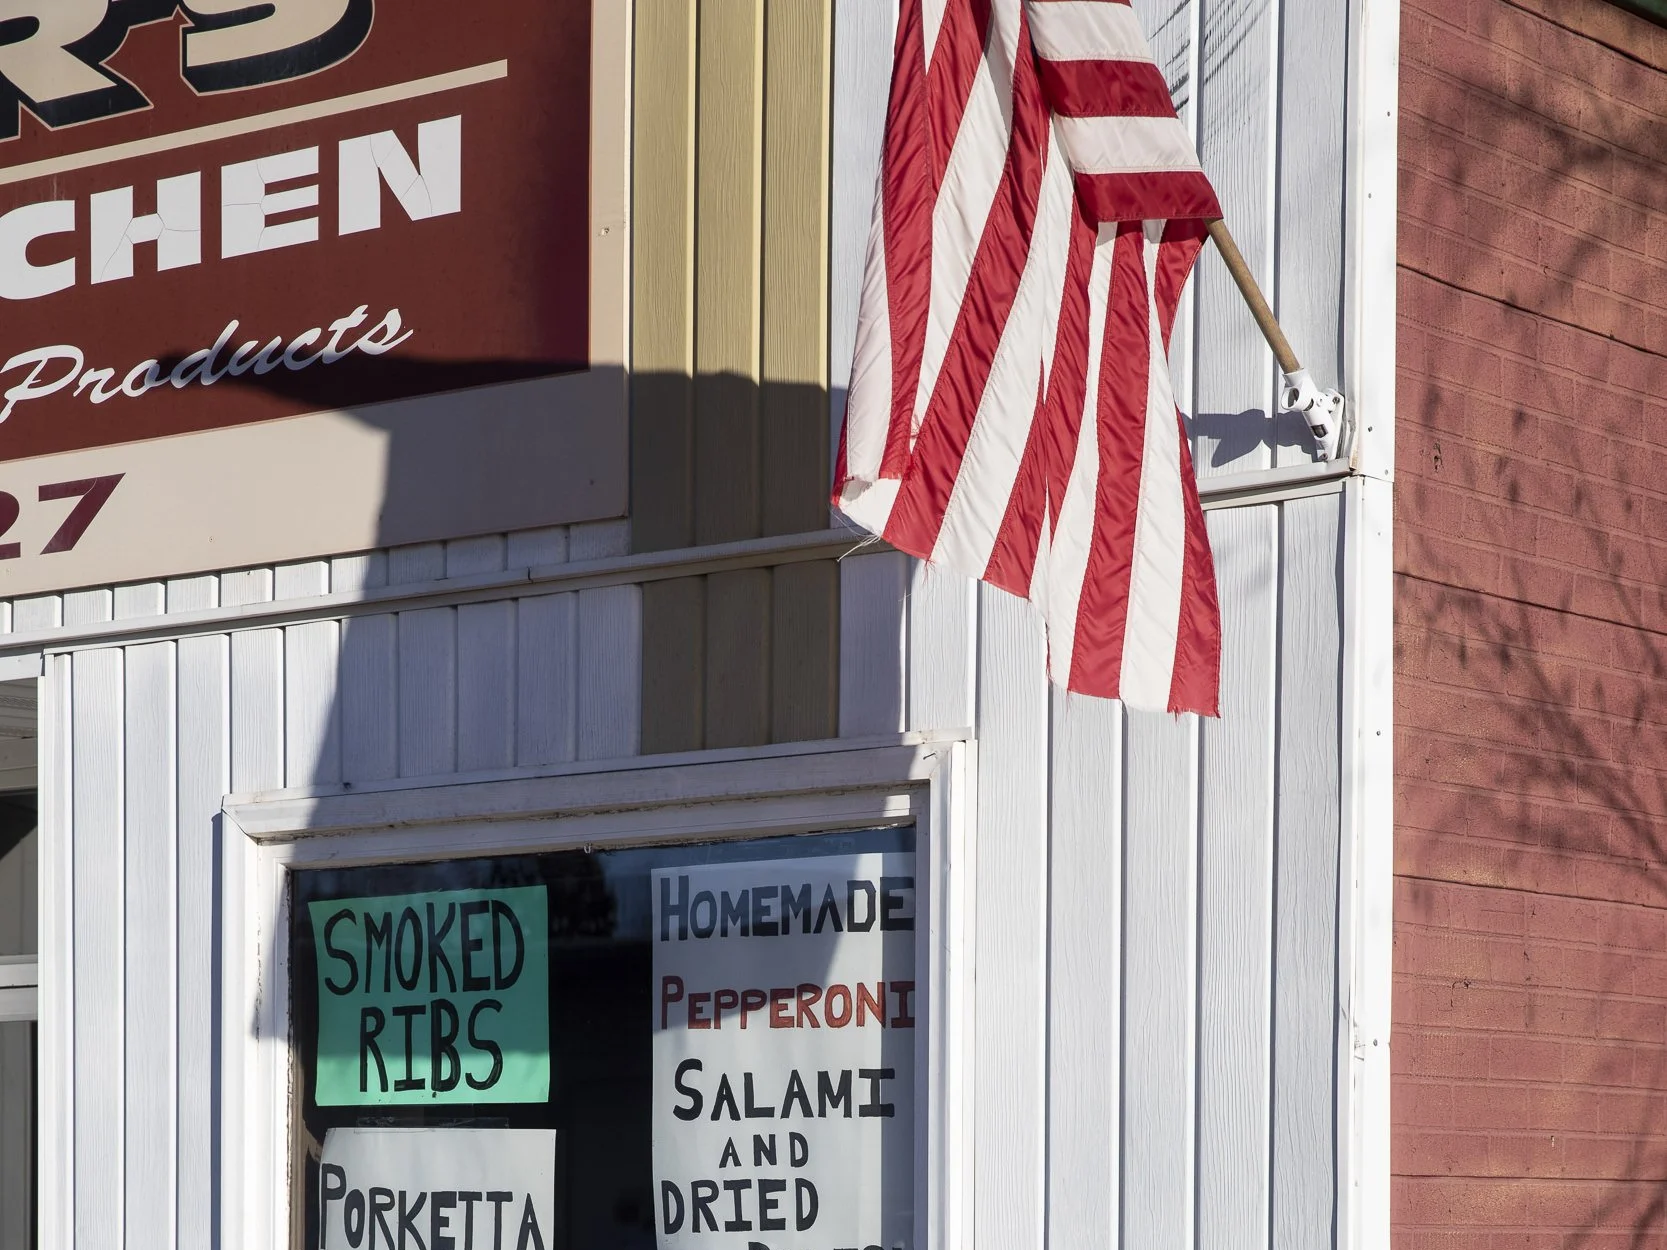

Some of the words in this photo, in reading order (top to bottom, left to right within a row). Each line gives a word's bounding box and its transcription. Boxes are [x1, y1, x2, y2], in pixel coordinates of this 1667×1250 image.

[0, 304, 414, 423] Products
[660, 876, 915, 941] HOMEMADE
[323, 900, 525, 996] SMOKED
[661, 975, 915, 1030] PEPPERONI
[359, 999, 503, 1093] RIBS
[673, 1058, 896, 1121] SALAMI
[718, 1131, 809, 1168] AND
[661, 1178, 819, 1235] DRIED
